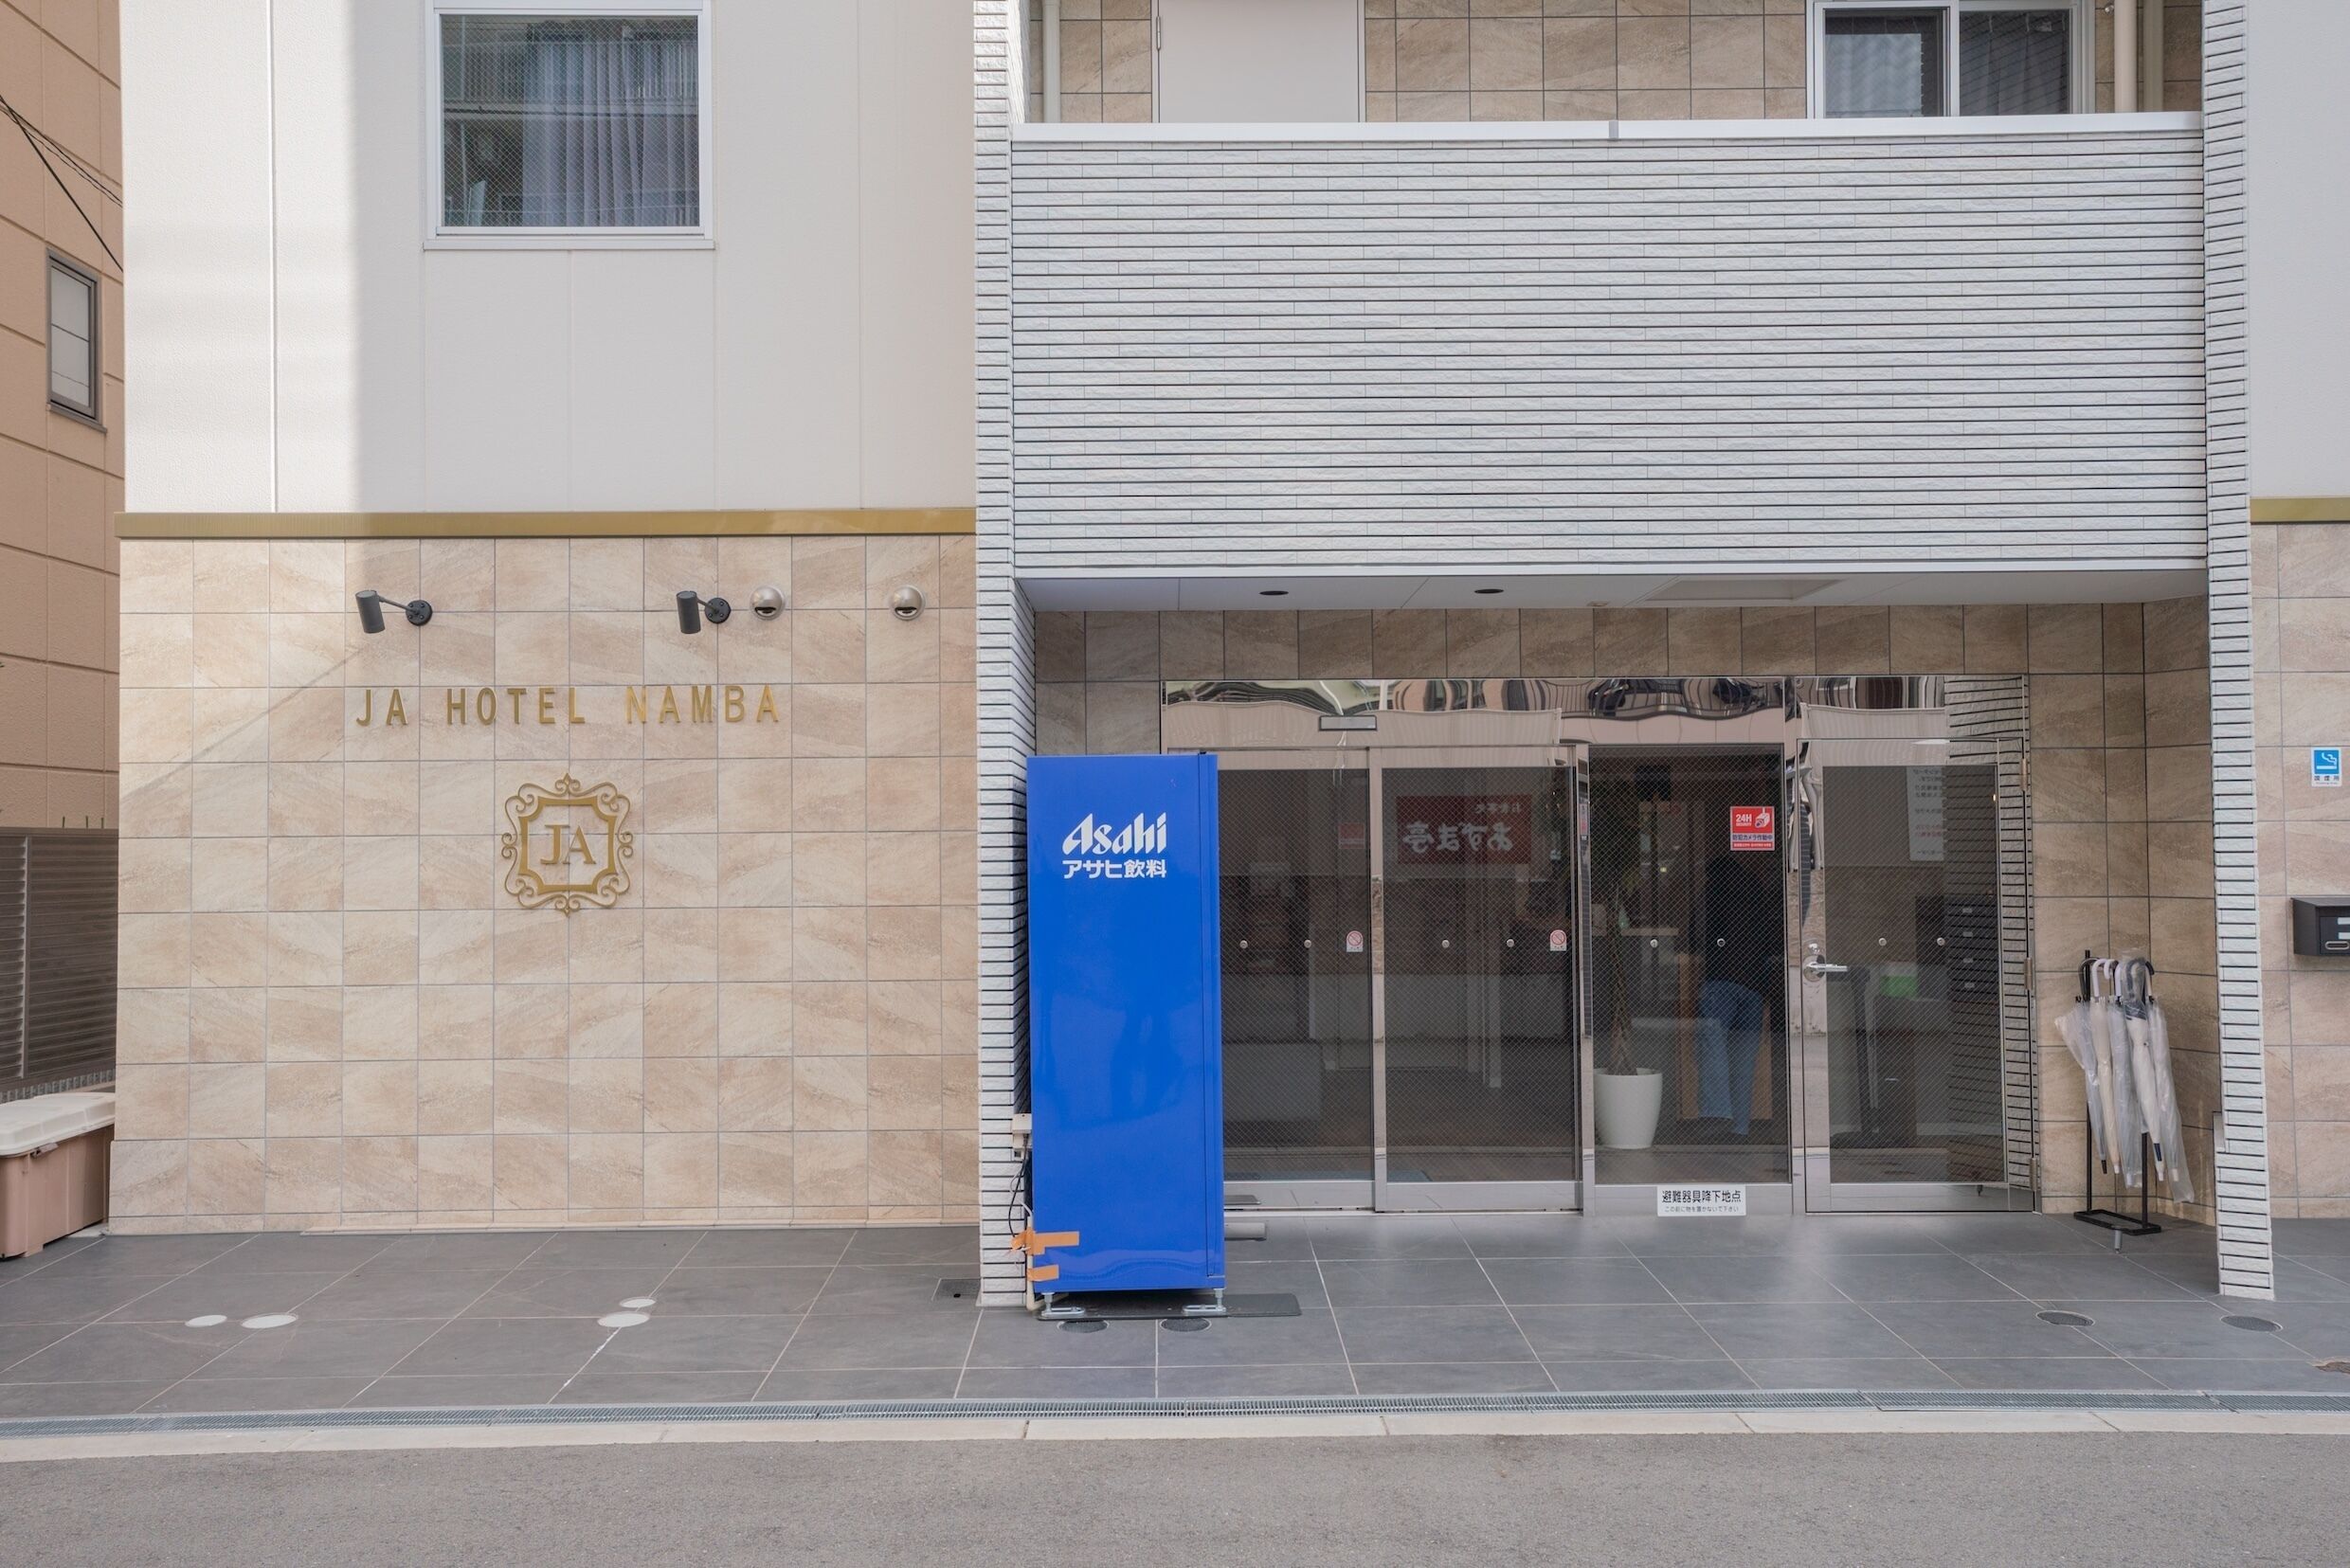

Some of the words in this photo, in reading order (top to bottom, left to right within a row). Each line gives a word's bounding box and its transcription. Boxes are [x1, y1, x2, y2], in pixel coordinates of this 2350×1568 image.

[355, 688, 408, 727] JA
[446, 687, 586, 726] HOTEL
[624, 685, 780, 725] NAMBA
[1735, 814, 1752, 822] 24H
[540, 824, 596, 865] JA
[1062, 812, 1166, 856] Asahi
[1062, 859, 1166, 879] アサヒ飲料
[1662, 1190, 1742, 1203] 避難器具降下地点
